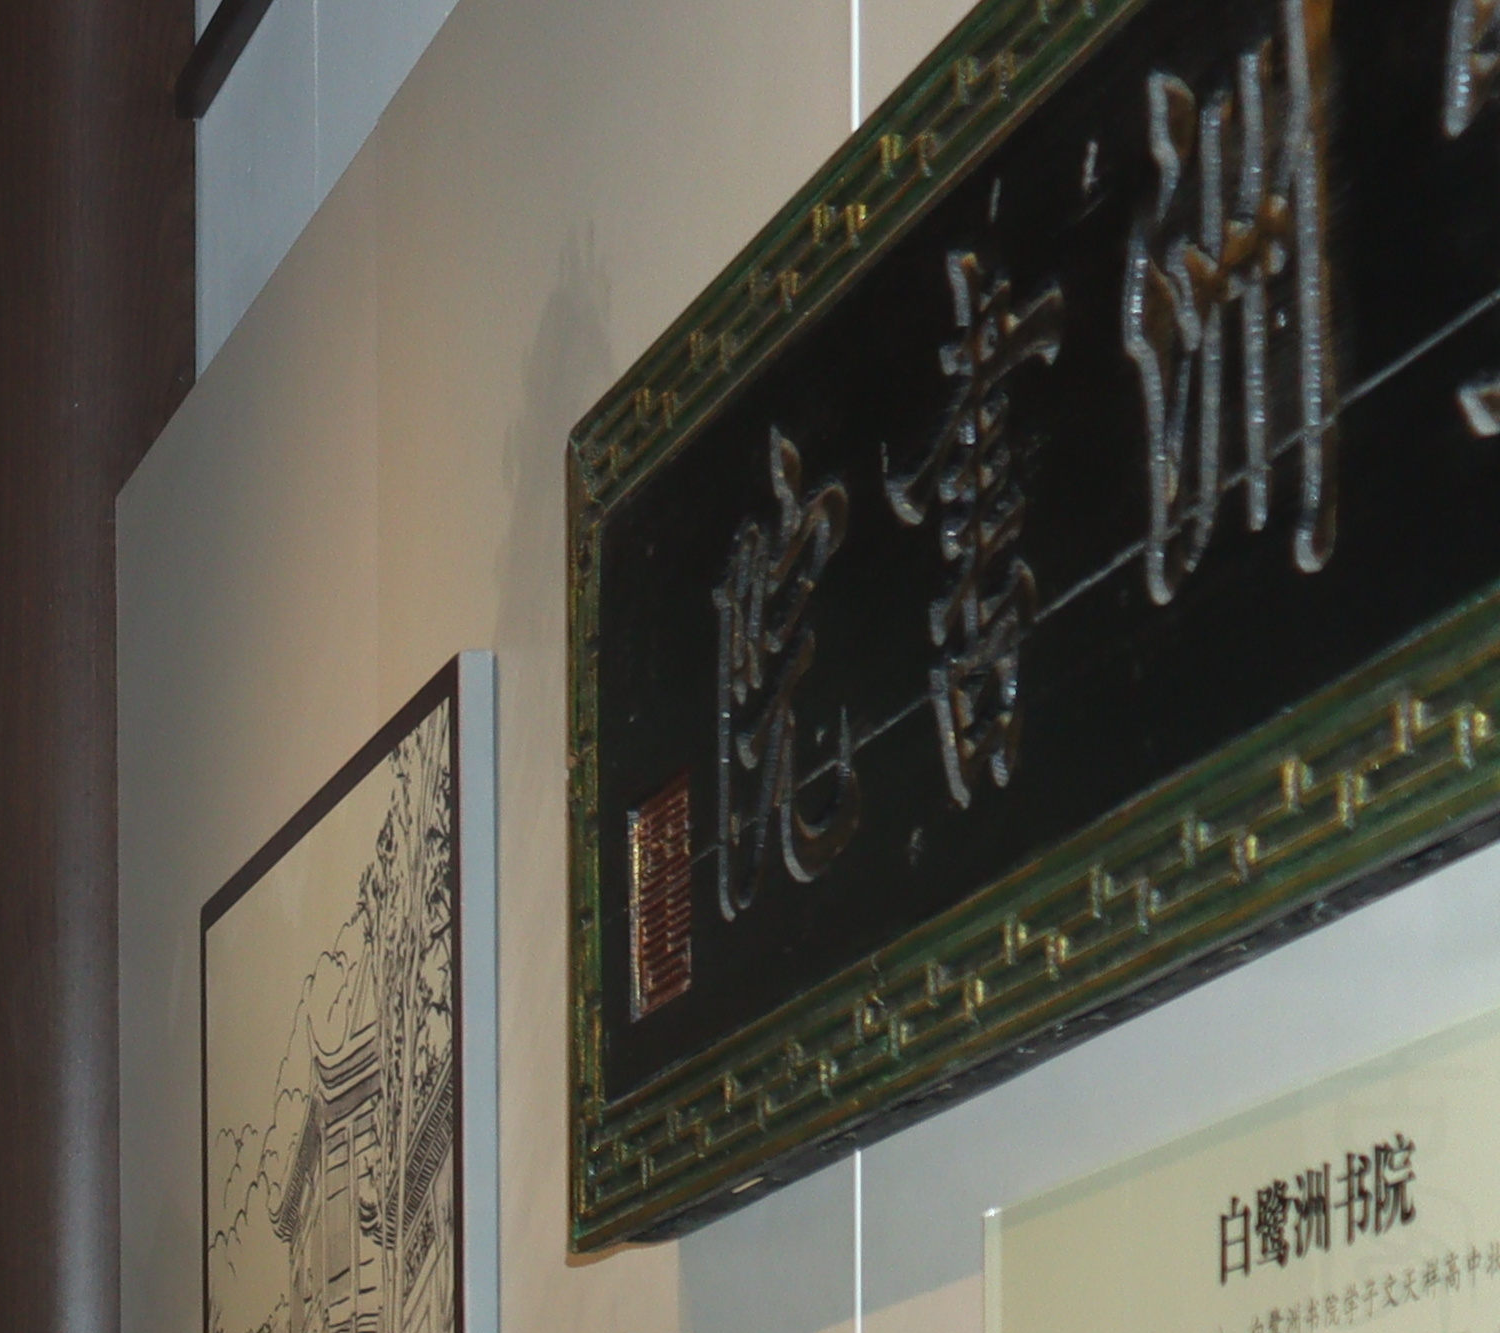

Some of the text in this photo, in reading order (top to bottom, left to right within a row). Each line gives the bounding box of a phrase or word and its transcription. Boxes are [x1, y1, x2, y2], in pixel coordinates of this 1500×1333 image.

[1219, 1132, 1417, 1287] 白鹭洲书院
